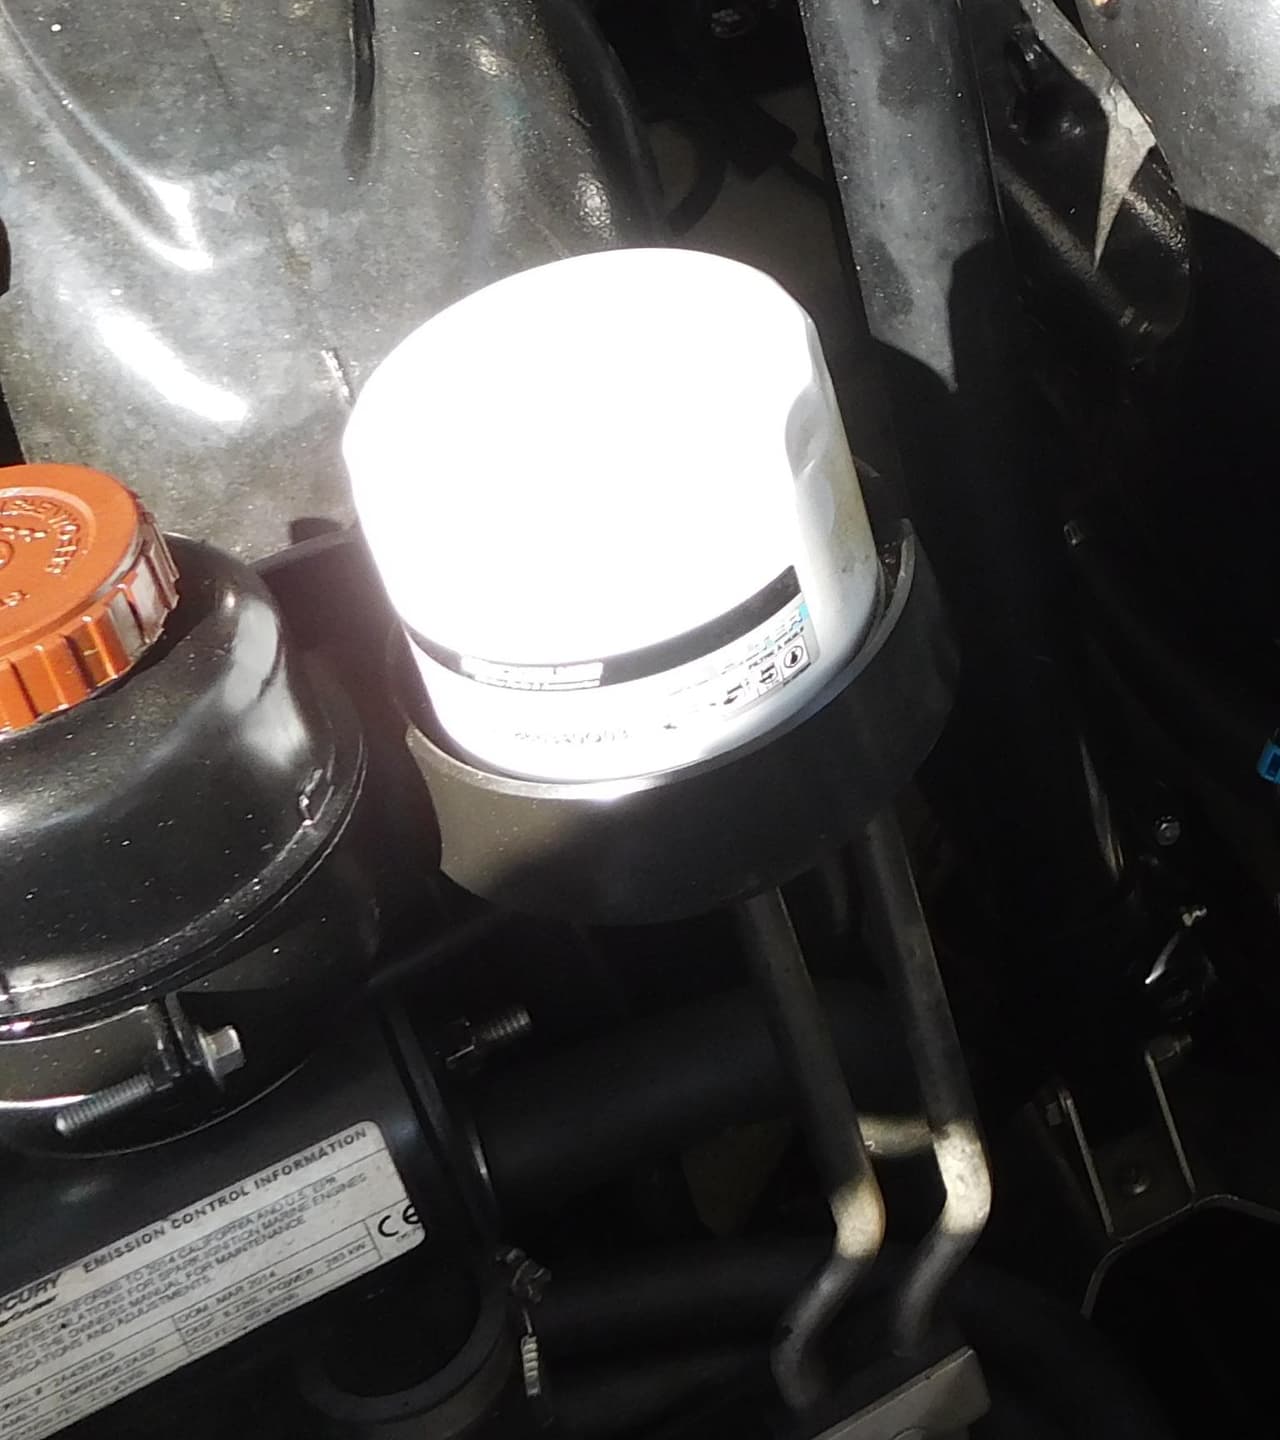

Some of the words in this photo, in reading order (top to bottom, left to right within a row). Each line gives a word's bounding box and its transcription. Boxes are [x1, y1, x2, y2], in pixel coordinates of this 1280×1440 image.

[0, 1271, 66, 1313] CURY
[80, 1224, 167, 1274] EMISSION
[169, 1184, 251, 1230] CONTROL
[251, 1127, 369, 1190] INFORMATION
[183, 1259, 214, 1281] FOR
[212, 1213, 307, 1266] MAINTENANCE
[124, 1269, 144, 1286] TO
[125, 1276, 155, 1297] FOR
